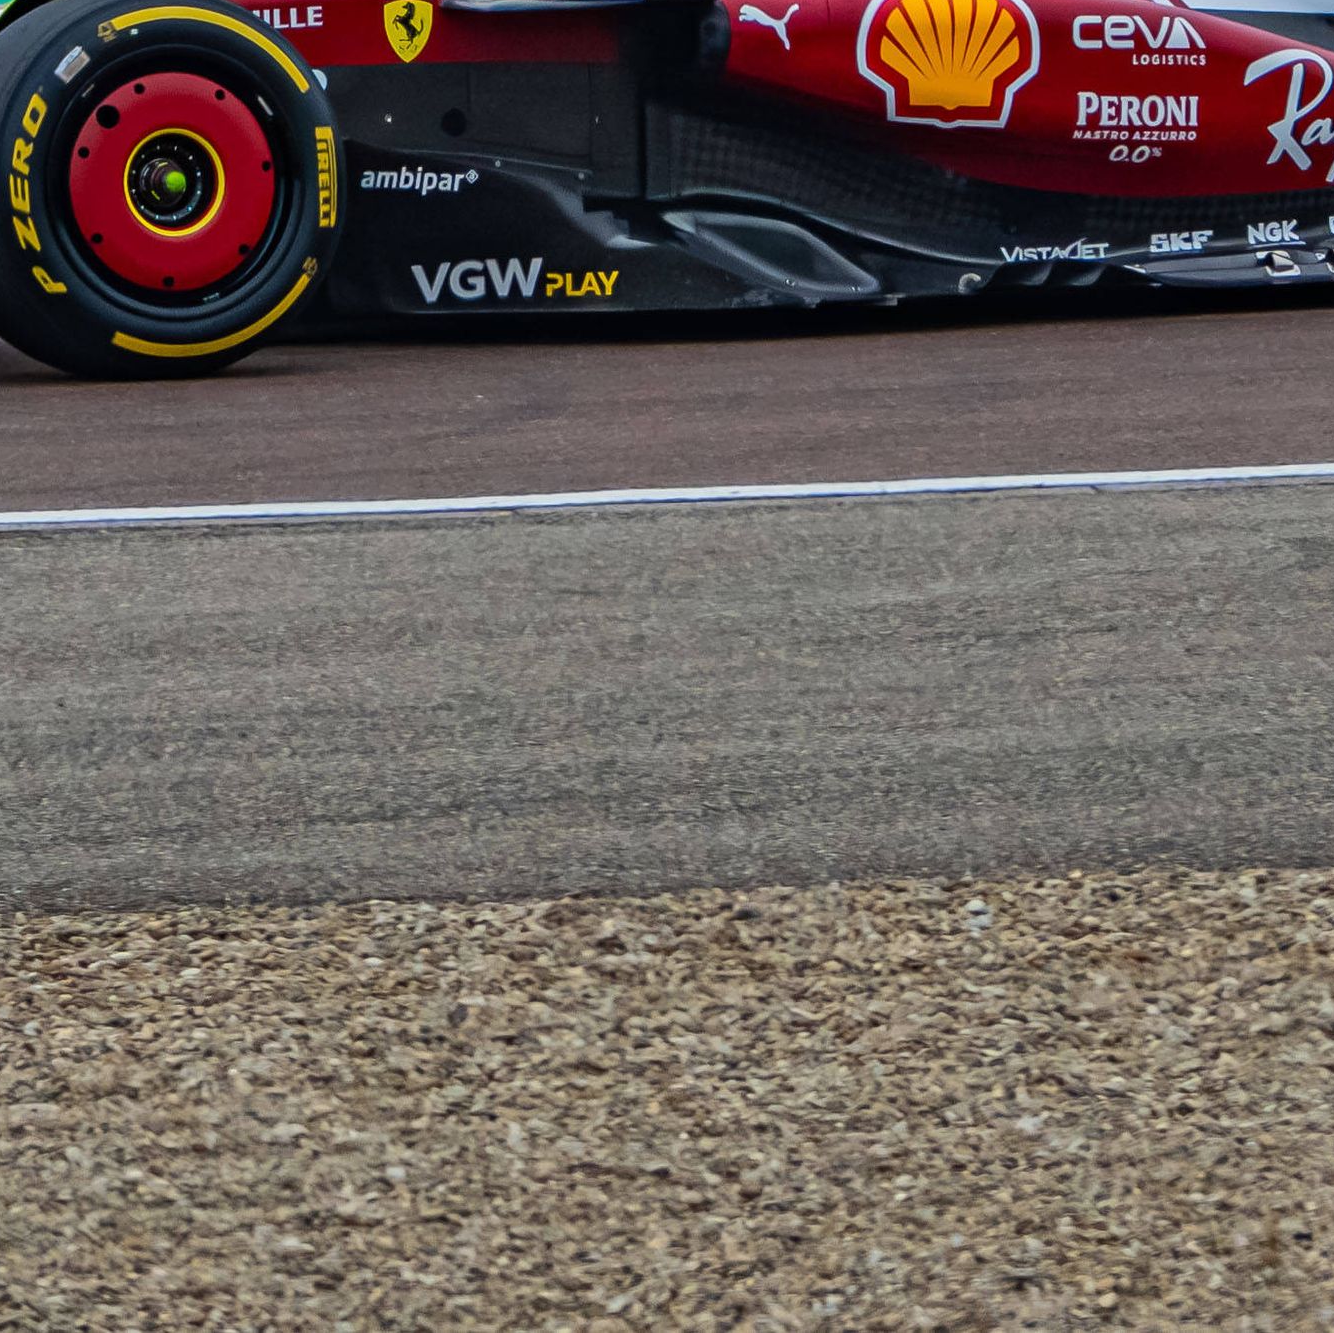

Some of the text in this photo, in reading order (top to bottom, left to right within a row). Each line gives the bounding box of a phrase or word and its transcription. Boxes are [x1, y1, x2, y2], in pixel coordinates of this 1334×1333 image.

[252, 6, 324, 30] ILLE
[1132, 54, 1207, 66] LOGISTICS
[1076, 91, 1199, 127] PERONI
[1072, 130, 1197, 141] NASTRO AZZURRO
[315, 126, 338, 228] PIRELLI
[360, 167, 464, 196] ambipar
[10, 93, 68, 294] P ZERO
[1149, 230, 1214, 253] SKF
[1247, 219, 1300, 245] NGK
[411, 257, 619, 304] VGW PLAY
